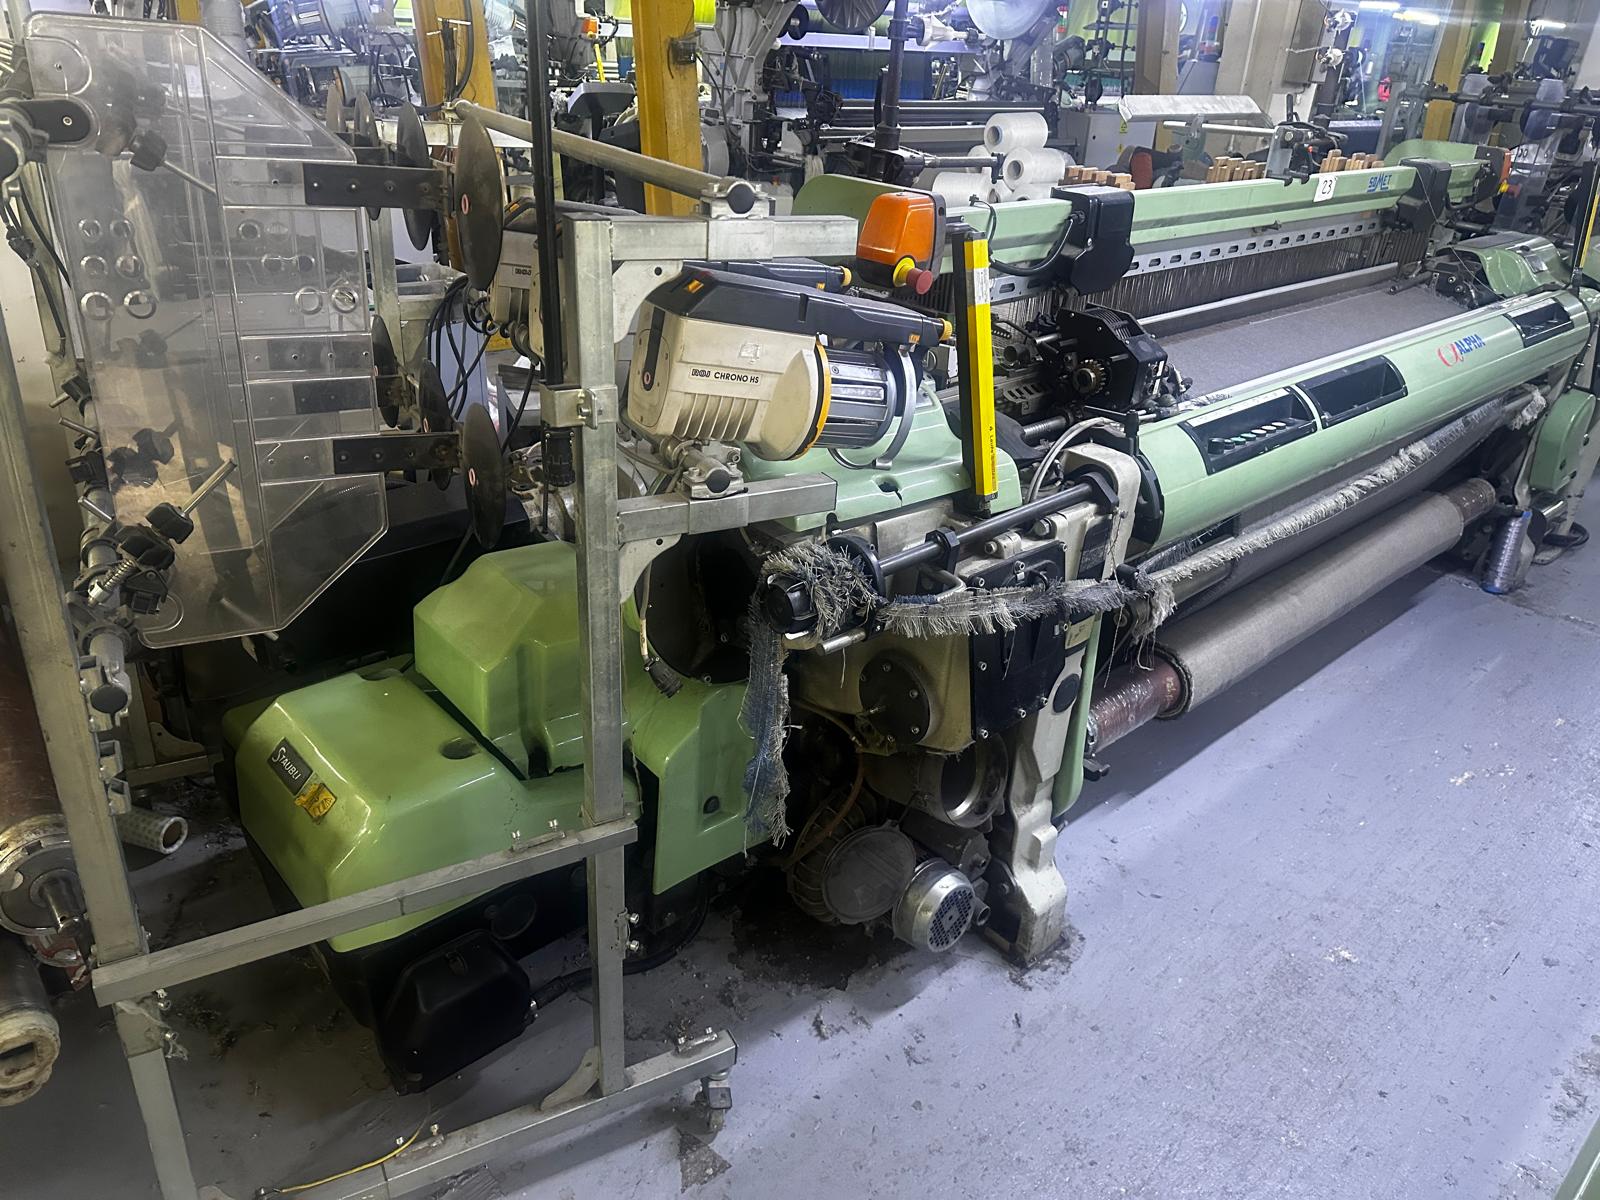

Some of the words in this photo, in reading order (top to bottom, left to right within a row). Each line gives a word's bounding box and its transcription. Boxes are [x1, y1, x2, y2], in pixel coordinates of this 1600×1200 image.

[1321, 179, 1334, 195] 23
[714, 371, 749, 382] CHRONO
[749, 376, 760, 384] HS
